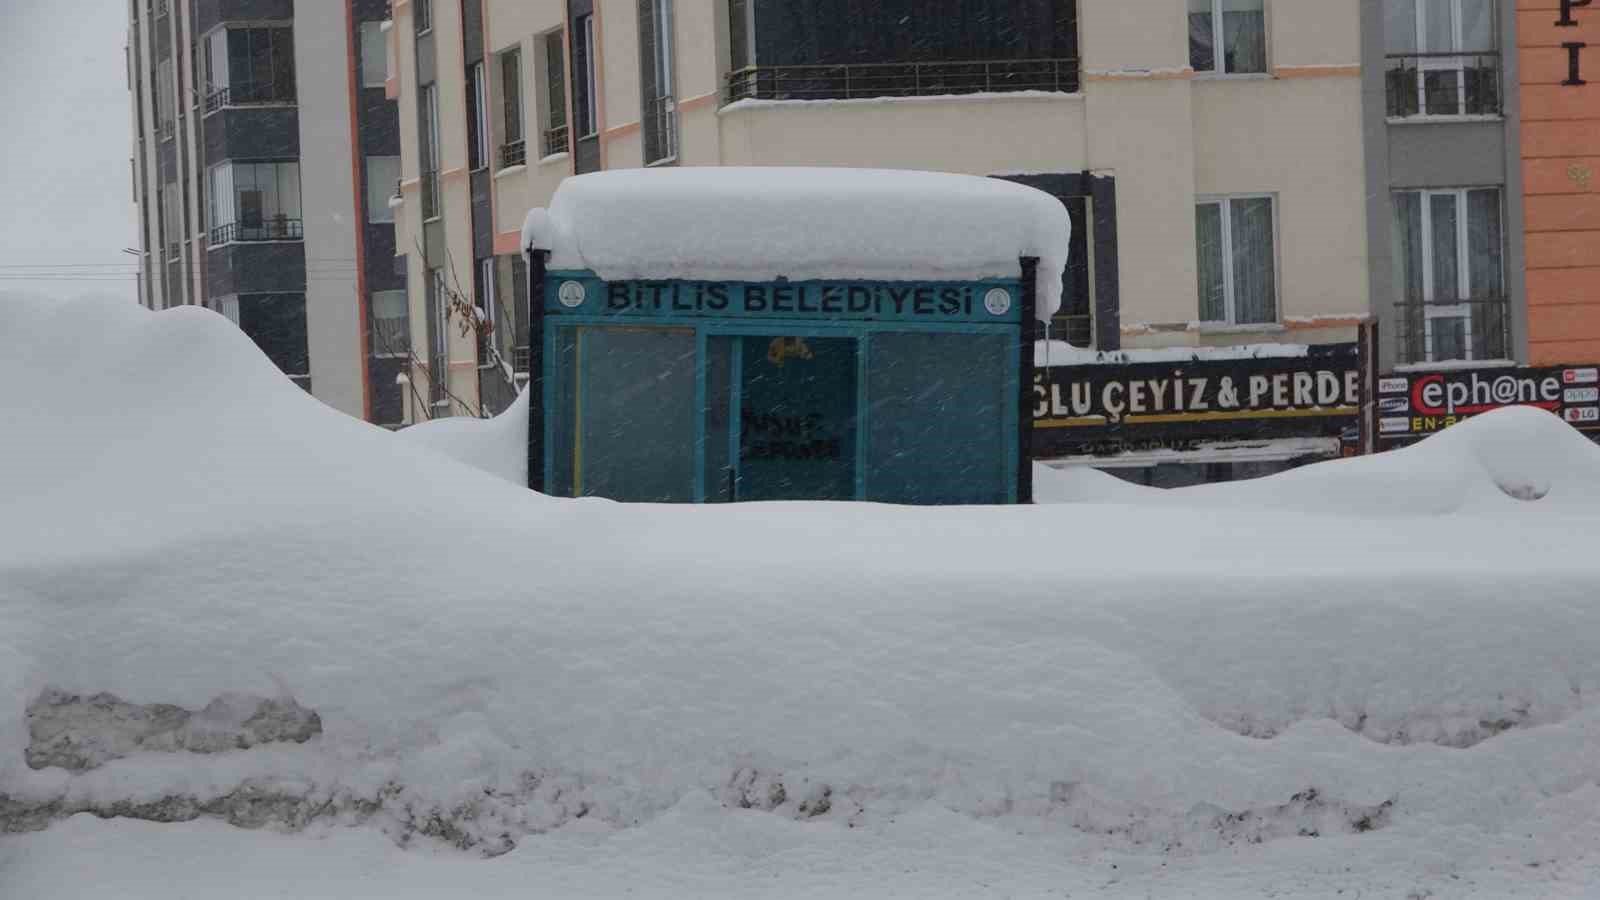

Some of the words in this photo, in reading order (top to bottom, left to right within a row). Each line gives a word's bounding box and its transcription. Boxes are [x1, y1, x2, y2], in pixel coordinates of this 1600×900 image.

[1102, 369, 1209, 423] ÇEYİZ
[1217, 376, 1239, 408] &
[1249, 370, 1359, 406] PERDE
